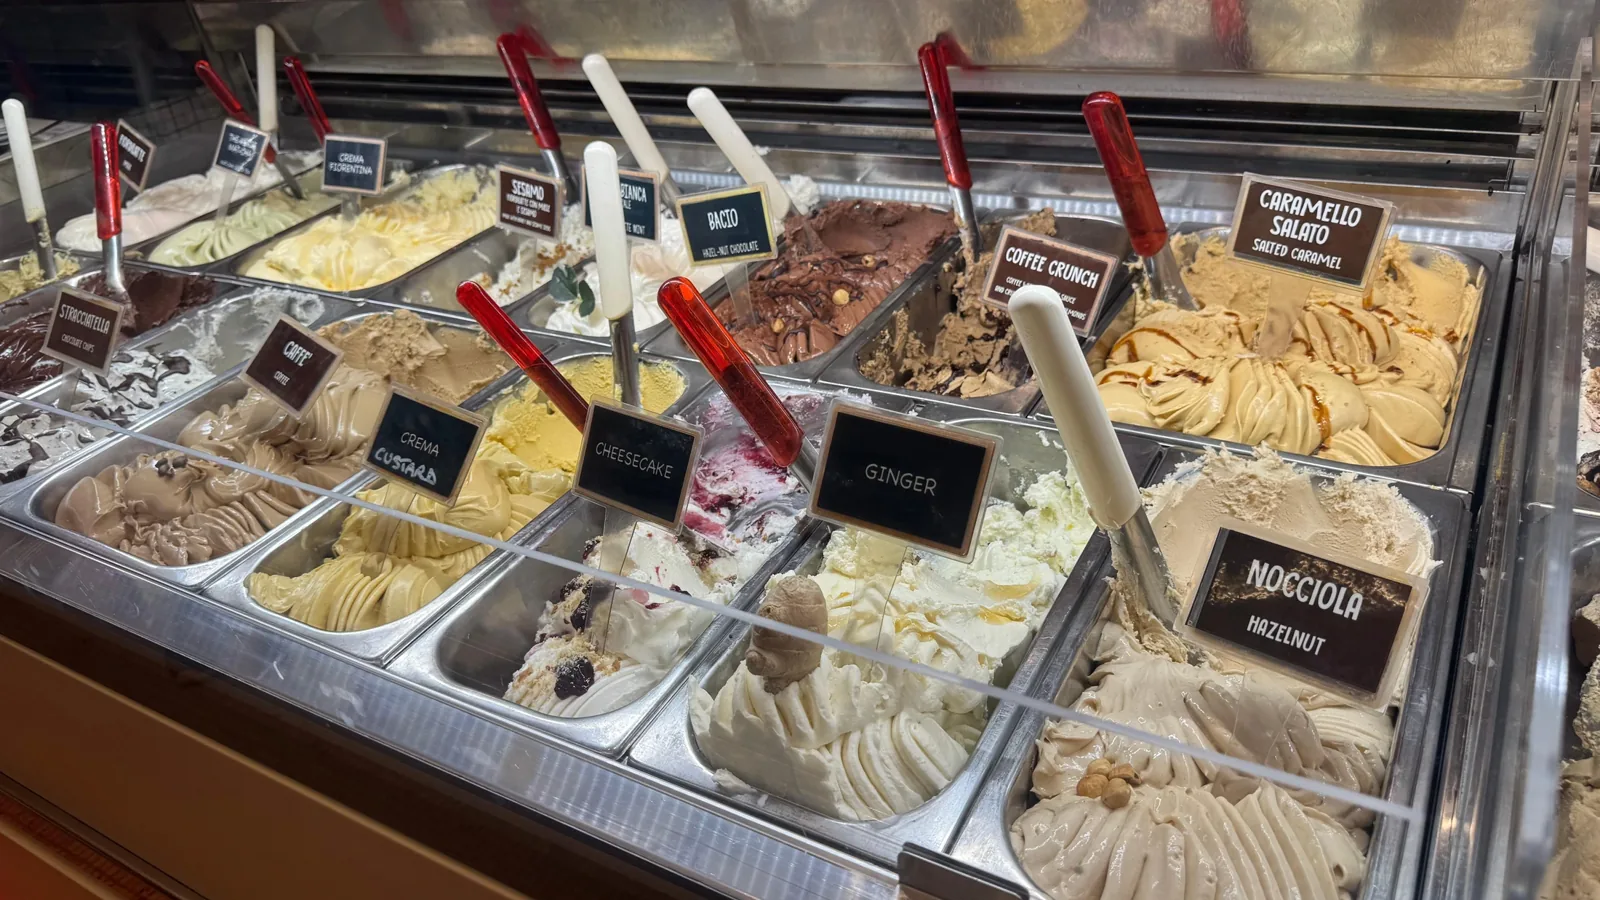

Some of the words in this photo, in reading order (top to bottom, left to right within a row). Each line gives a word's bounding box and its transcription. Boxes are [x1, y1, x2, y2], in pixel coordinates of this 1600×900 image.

[329, 161, 373, 175] FIORENTINA
[339, 152, 364, 164] CREMA
[511, 179, 545, 201] SESAMO
[620, 183, 647, 203] BIANCA
[707, 208, 738, 231] BACIO
[1259, 189, 1362, 228] CARAMELLO
[1269, 215, 1330, 245] SALATO
[702, 245, 729, 258] HAZEL-NUT
[729, 240, 759, 254] CHOCOLATE
[1252, 238, 1289, 257] SALTED
[1290, 247, 1342, 270] CARAMEL
[1005, 246, 1047, 273] COFFEE
[1048, 260, 1100, 289] CRUNCH
[1006, 276, 1022, 287] COFFEE
[59, 303, 111, 335] STRACCIATELLA
[1064, 307, 1087, 321] LMONDS
[61, 333, 83, 349] CHOCOLATE
[82, 340, 95, 353] CHIPS
[273, 370, 290, 386] COFFEE
[400, 431, 440, 457] CREMA
[374, 447, 437, 486] CUSTARD
[595, 441, 674, 479] CHEESECAKE
[865, 463, 937, 496] GINGER
[1246, 558, 1364, 621] NOCCIOLA
[1247, 615, 1326, 656] HAZELNUT
